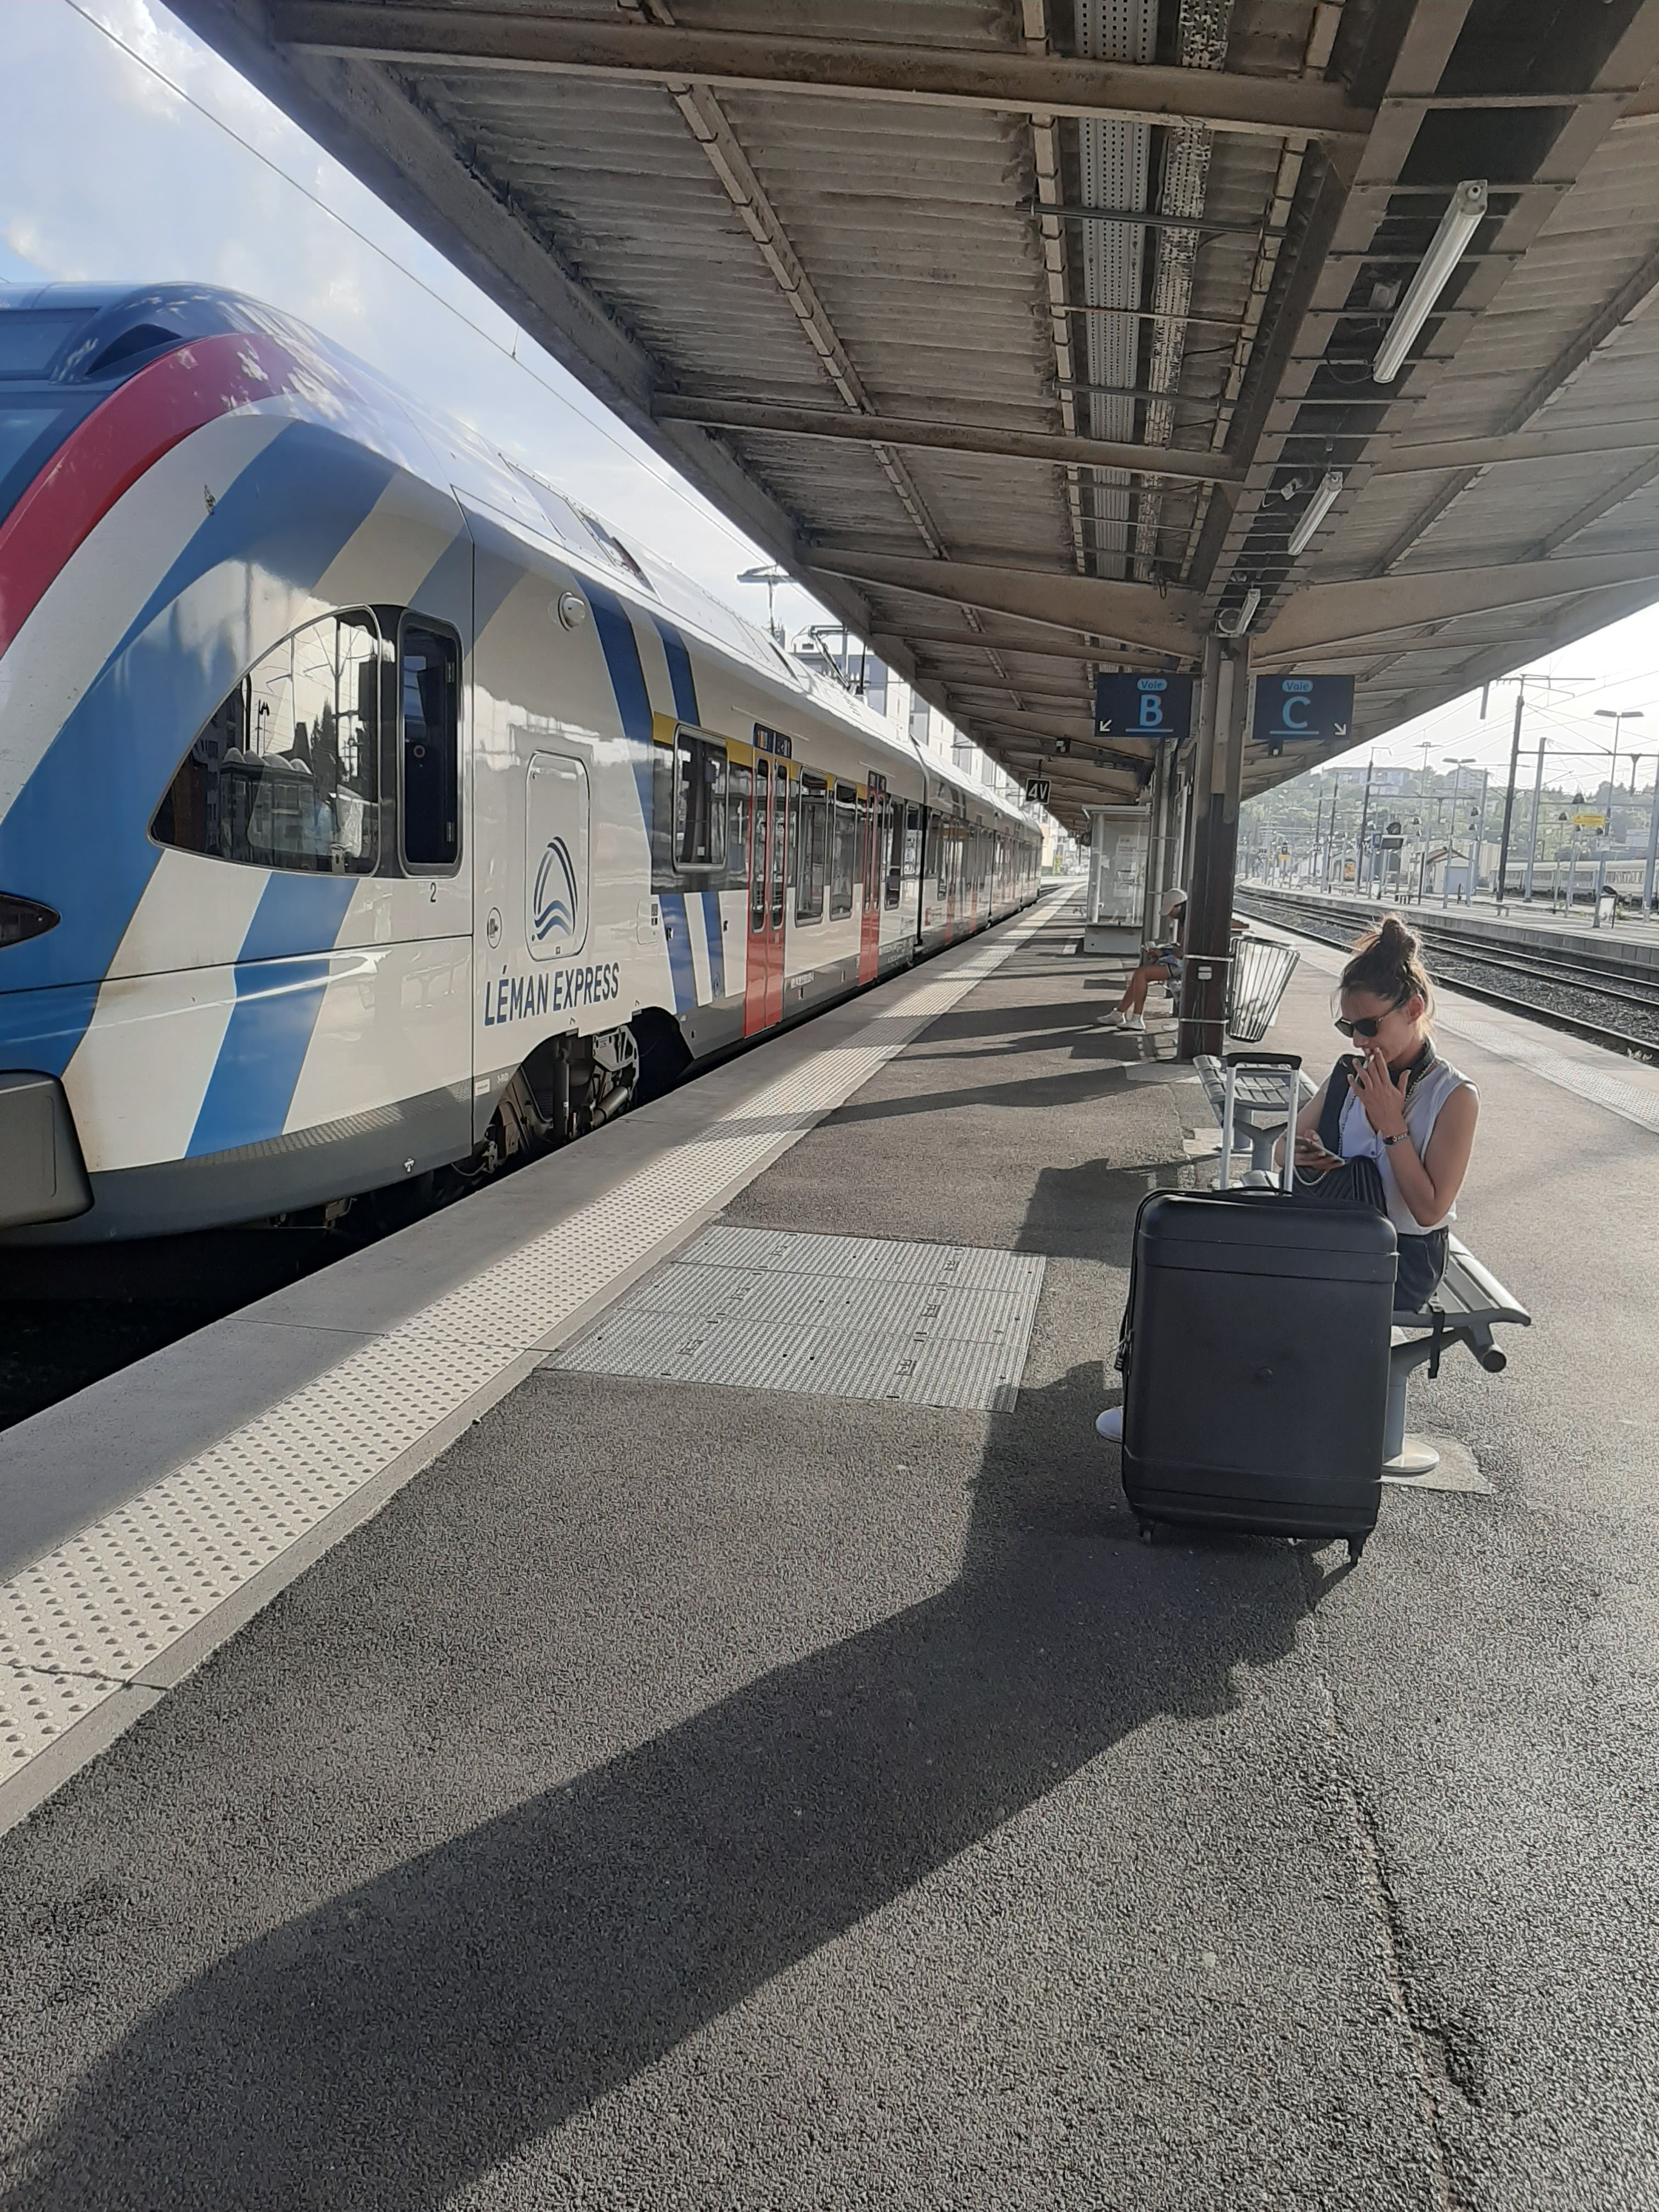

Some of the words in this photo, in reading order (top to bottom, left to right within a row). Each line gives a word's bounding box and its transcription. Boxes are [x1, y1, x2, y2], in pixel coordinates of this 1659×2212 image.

[1141, 680, 1164, 689] Voie
[1286, 681, 1310, 691] Voie
[1139, 694, 1163, 726] B
[1283, 696, 1311, 729] C
[1028, 782, 1048, 799] 4V
[430, 882, 437, 903] 2
[484, 964, 549, 1026] LÉMAN
[553, 962, 619, 1012] EXPRESS
